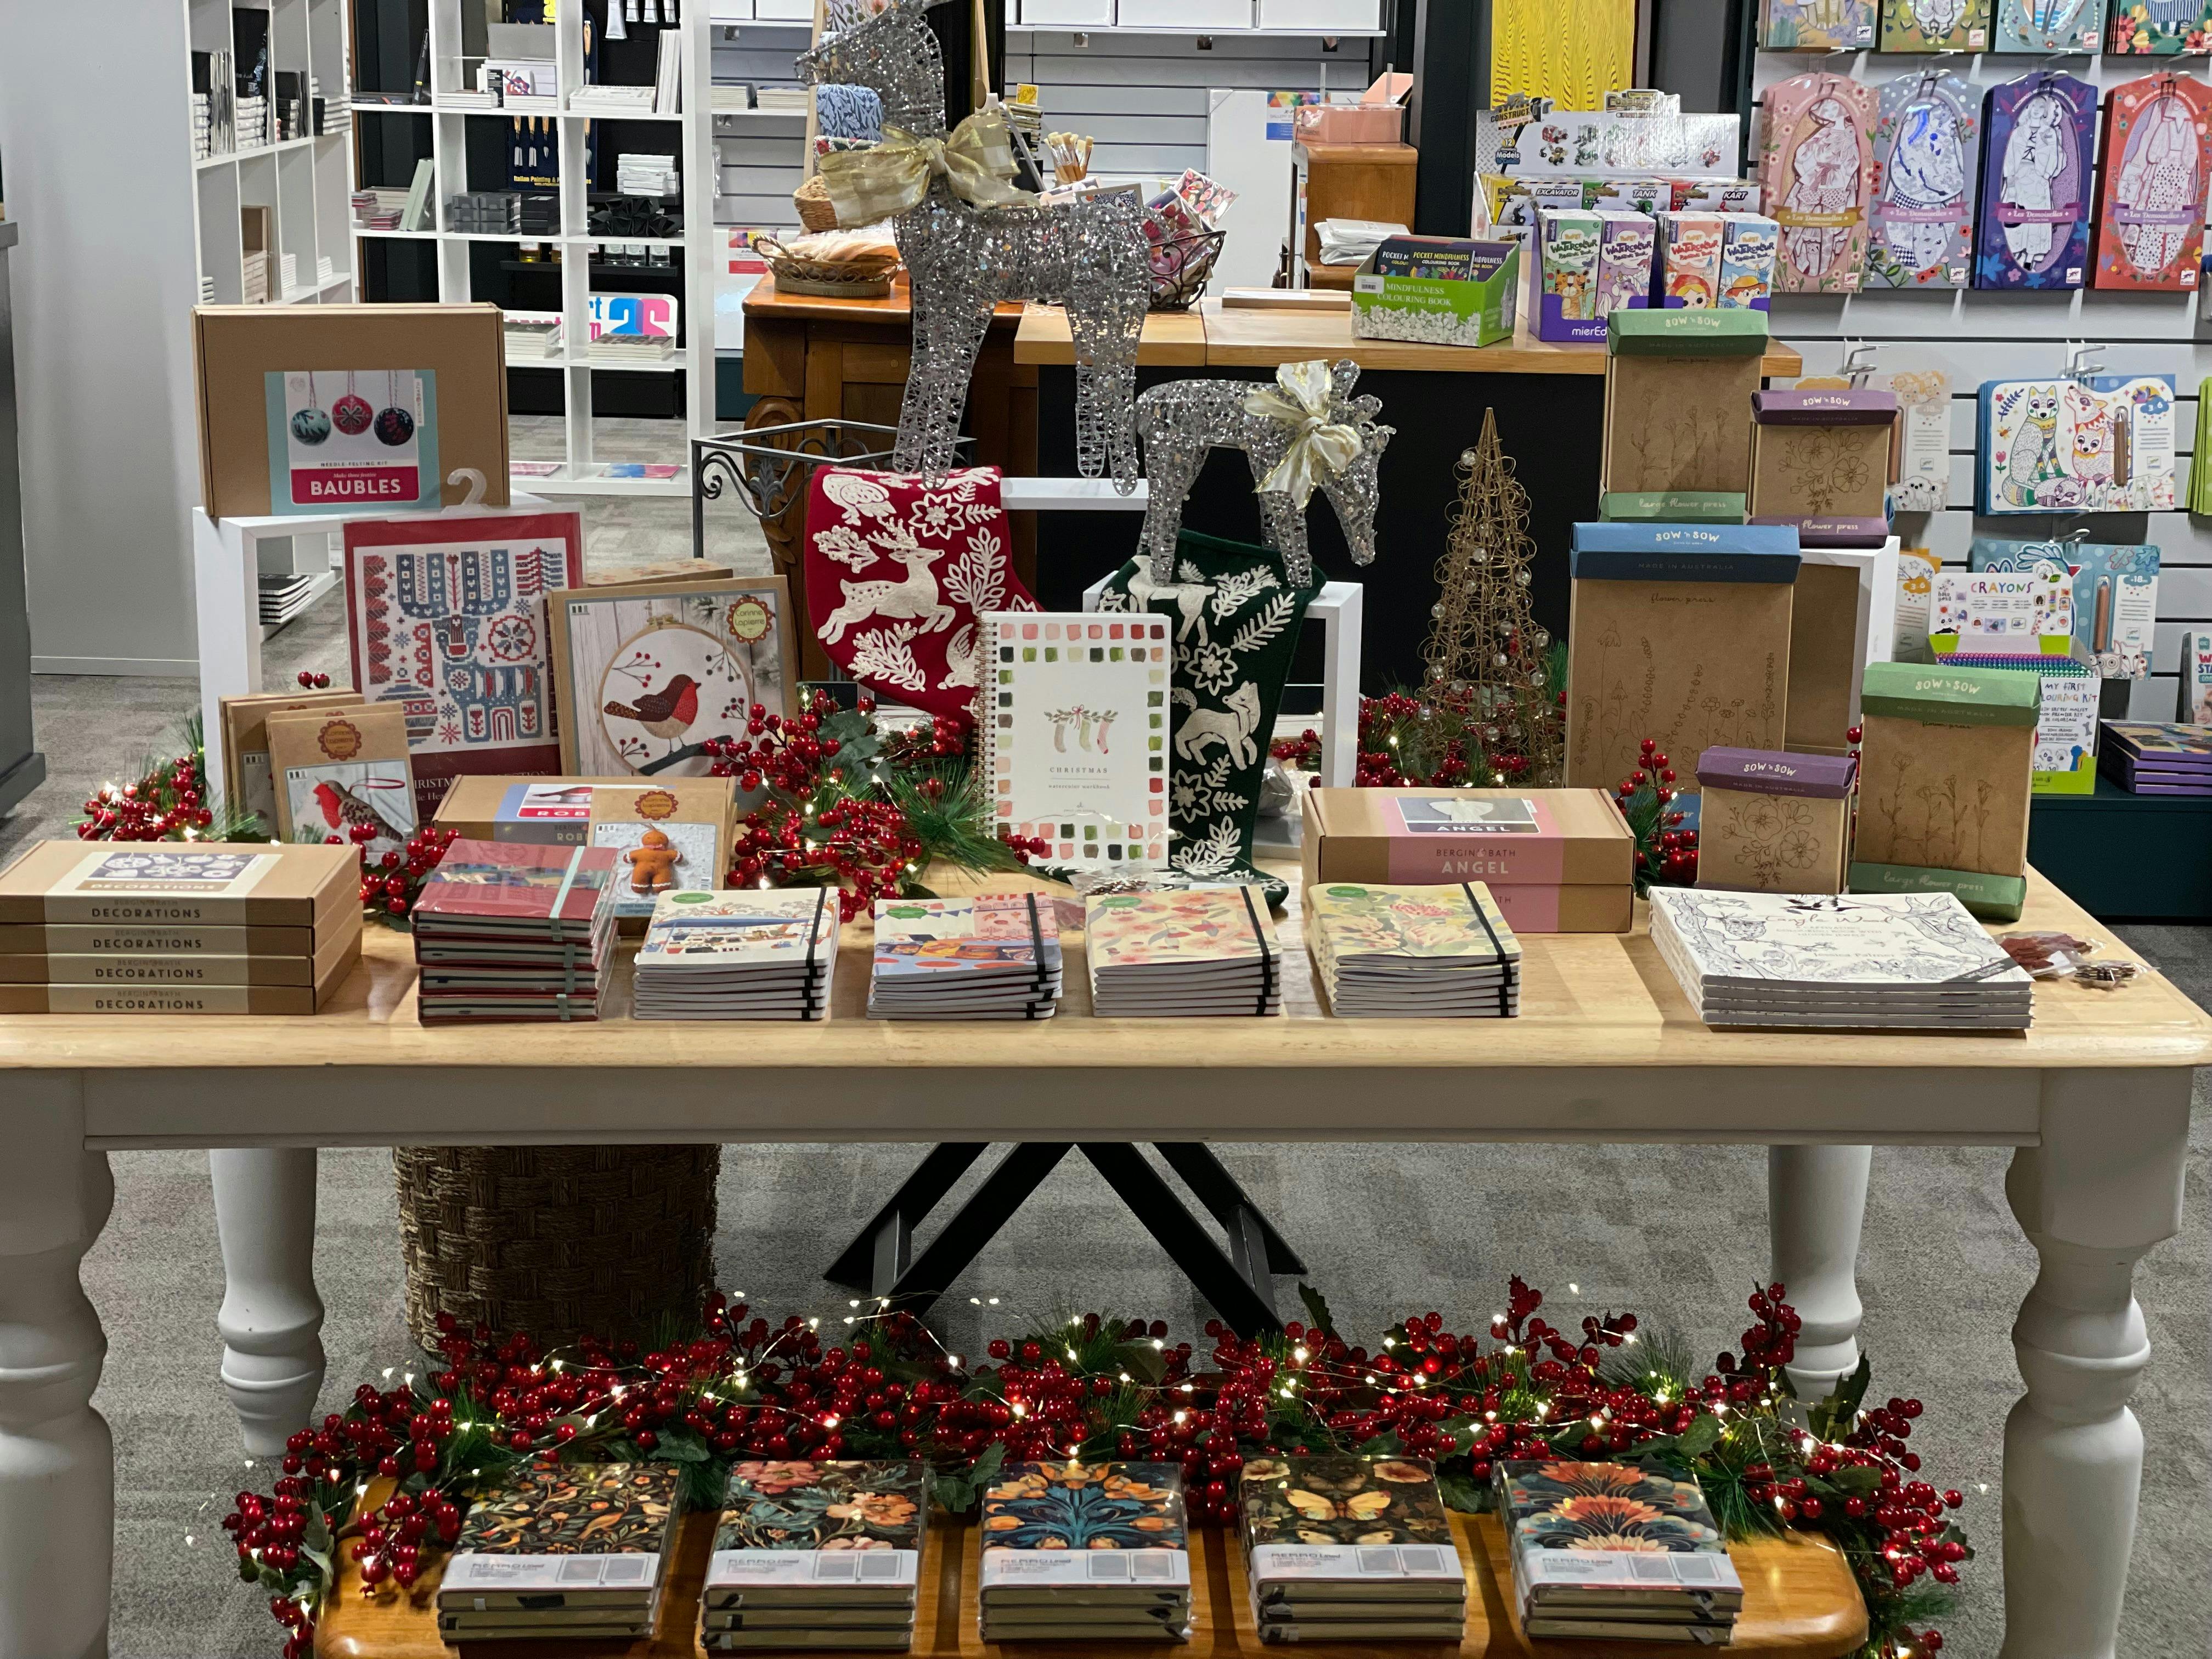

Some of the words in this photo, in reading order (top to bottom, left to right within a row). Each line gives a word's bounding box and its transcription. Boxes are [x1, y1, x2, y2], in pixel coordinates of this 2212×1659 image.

[1496, 151, 1520, 159] Models
[1632, 189, 1657, 198] TANK
[1723, 191, 1748, 200] KART
[1382, 251, 1400, 259] POCKET
[1434, 252, 1470, 261] MINDFULNESS
[1474, 256, 1503, 264] NDFULNESS
[1386, 283, 1444, 295] MINDFULNESS
[1377, 294, 1426, 304] COLOURING
[1428, 297, 1452, 306] BOOK
[1666, 317, 1688, 328] SOW
[1697, 317, 1721, 328] SOW
[1572, 327, 1608, 336] mierEd
[1803, 397, 1822, 406] SOW
[1830, 397, 1850, 407] SOW
[311, 478, 401, 495] BAUBLES
[1639, 498, 1666, 512] large
[1669, 498, 1700, 508] flower
[1703, 501, 1726, 510] press
[1802, 520, 1832, 530] flower
[1836, 523, 1859, 533] press
[1655, 531, 1681, 542] SOW
[1692, 531, 1720, 543] SOW
[1971, 582, 2034, 594] CRAYONS
[1651, 592, 1683, 603] flower
[1685, 596, 1716, 604] press
[735, 608, 763, 617] Corinne
[734, 618, 765, 626] Lapierre
[1915, 679, 1943, 691] SOW
[1953, 680, 1981, 694] SOW
[1743, 762, 1767, 772] SOW
[1774, 765, 1797, 777] SOW
[1765, 783, 1806, 793] AUSTRALIA
[1436, 849, 1475, 857] BERGIN
[1442, 860, 1509, 874] ANGEL
[1884, 871, 1914, 889] large
[1918, 874, 1952, 888] flower
[1956, 882, 1984, 892] press
[92, 908, 201, 918] DECORATIONS
[1765, 915, 1826, 927] Tangle
[1836, 916, 1894, 924] Wood
[93, 939, 202, 949] DECORATIONS
[95, 968, 203, 978] DECORATIONS
[95, 1000, 204, 1009] DECORATIONS
